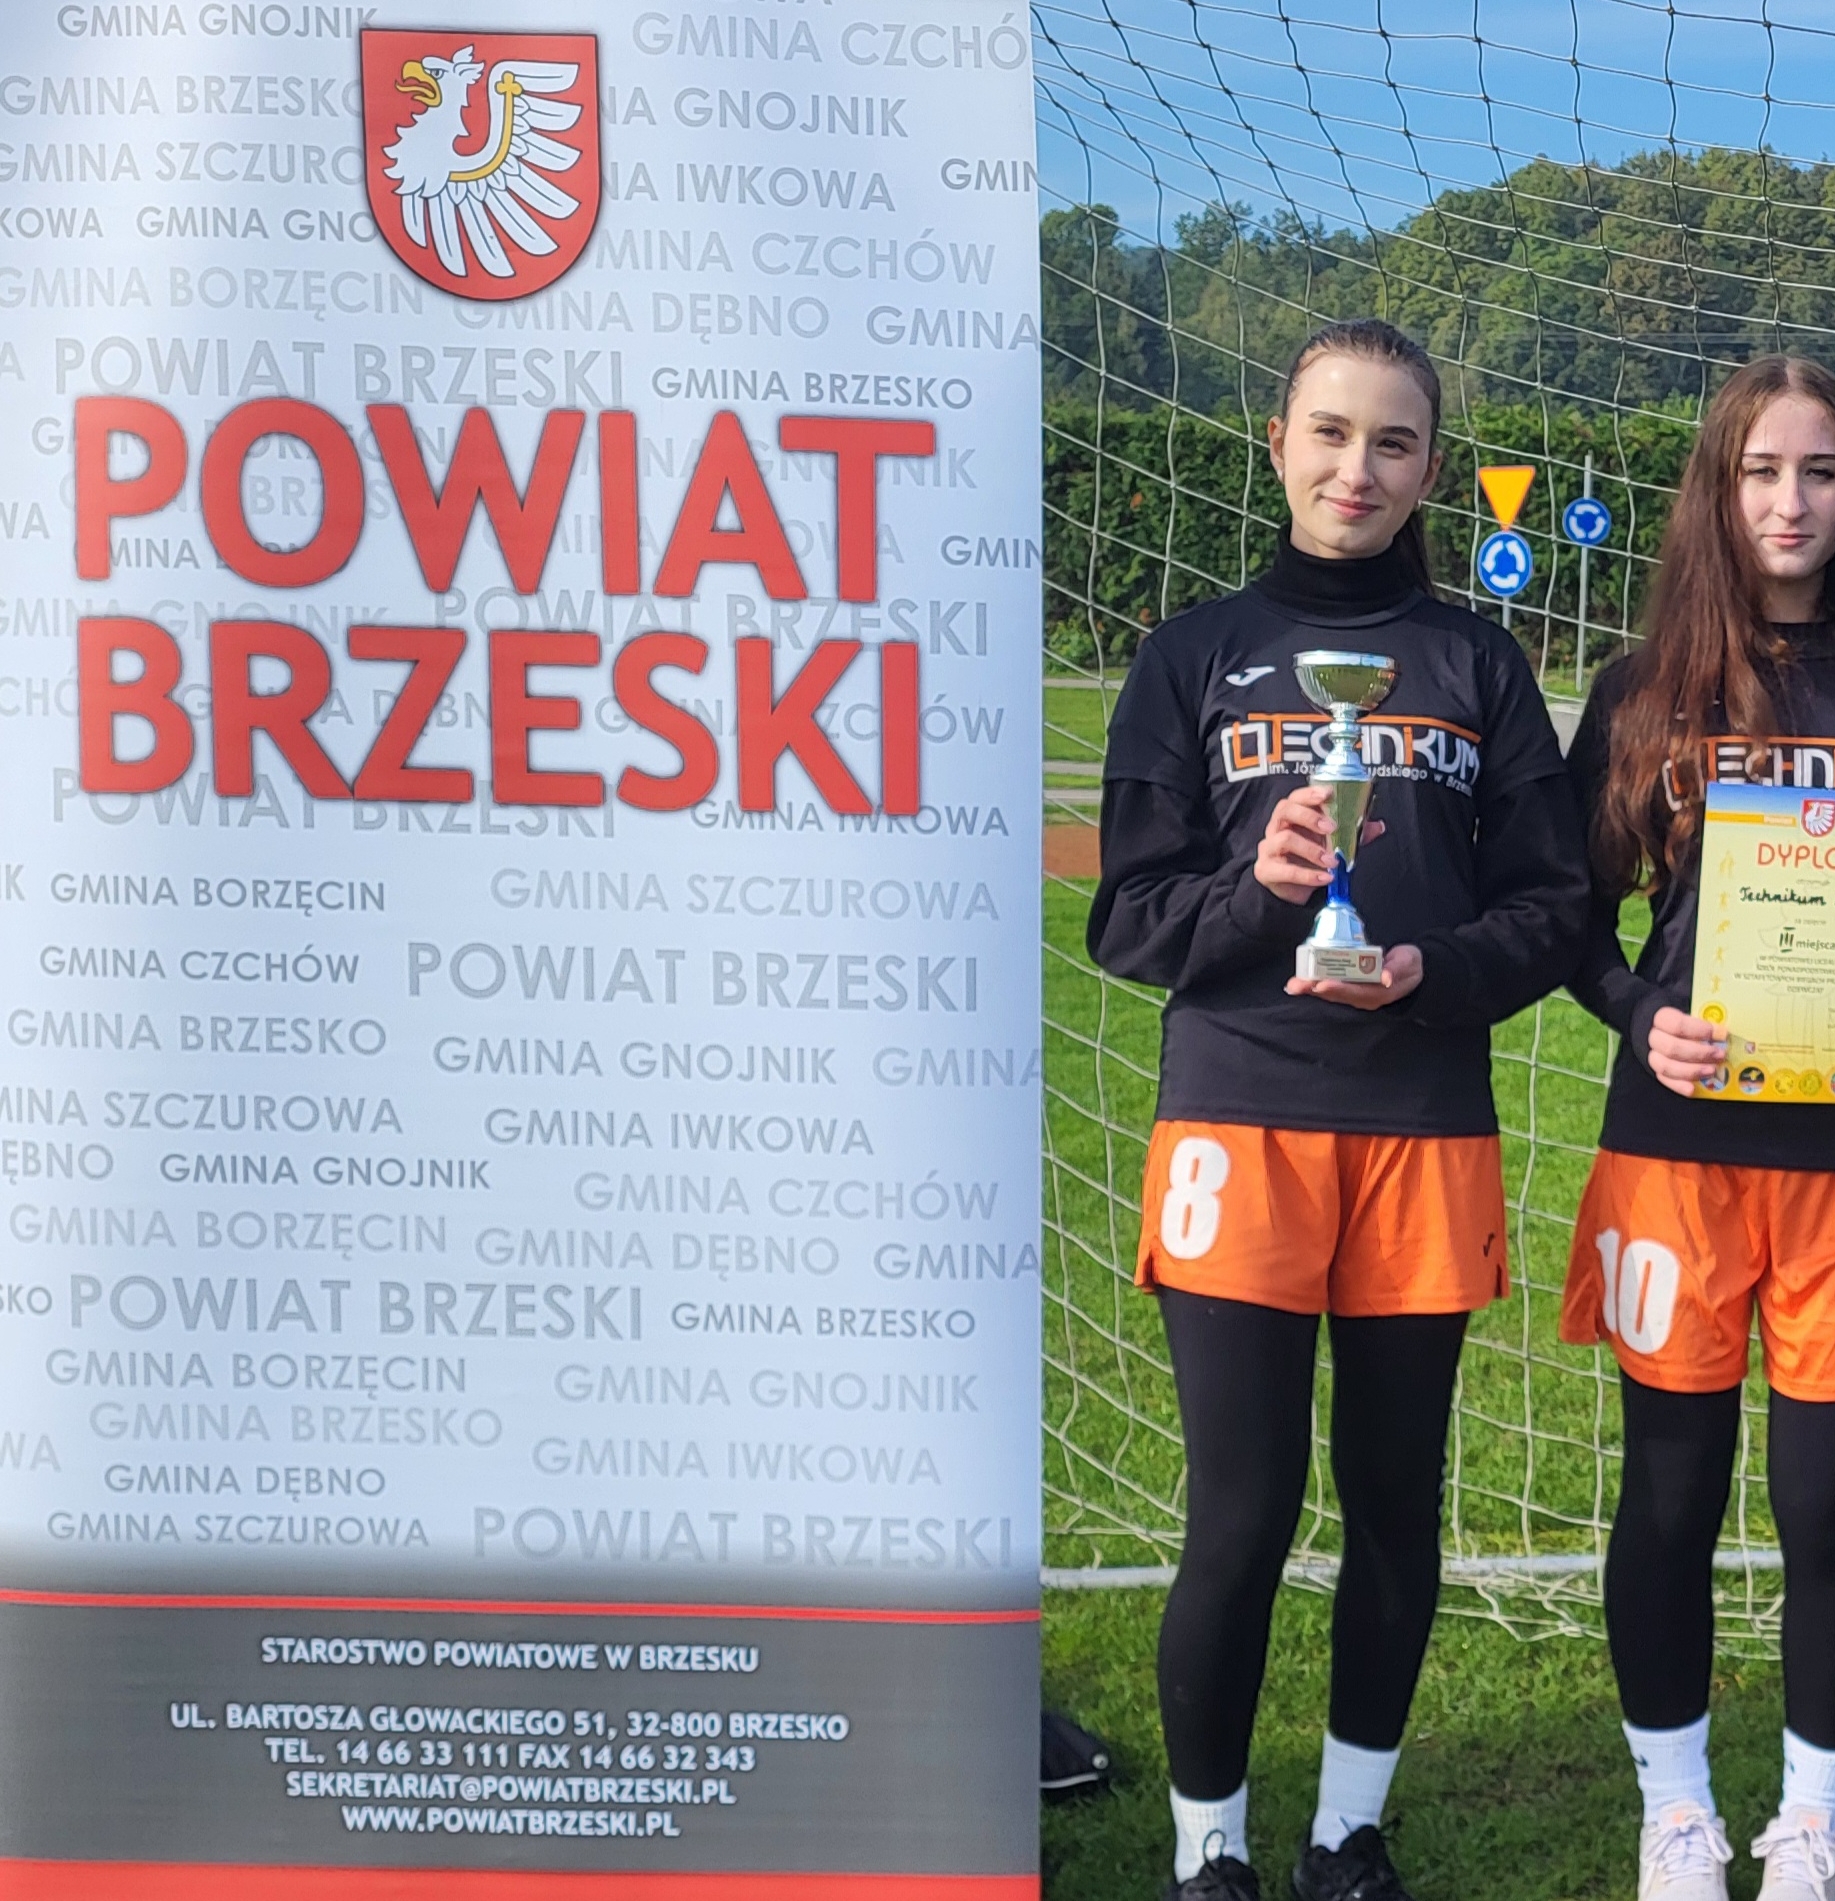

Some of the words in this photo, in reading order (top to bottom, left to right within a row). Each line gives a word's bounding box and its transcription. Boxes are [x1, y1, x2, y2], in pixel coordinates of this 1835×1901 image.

[57, 3, 187, 38] GMINA
[632, 12, 822, 63] GMINA
[0, 75, 159, 116] GMINA
[674, 86, 908, 138] GNOJNIK
[676, 162, 895, 212] IWKOWA
[136, 205, 269, 240] GMINA
[595, 229, 733, 272] MINA
[752, 228, 994, 285] CZCHÓW
[169, 266, 424, 322] BORZĘCIN
[652, 292, 829, 344] DĘBNO
[867, 306, 1040, 350] GMINA
[55, 336, 325, 397] POWIAT
[353, 343, 622, 408] BRZESKI
[652, 367, 790, 402] GMINA
[804, 371, 973, 410] BRZESKO
[74, 395, 936, 603] POWIAT
[76, 614, 920, 816] BRZESKI
[50, 873, 179, 908] GMINA
[192, 877, 386, 918] BORZĘCIN
[490, 867, 669, 913] GMINA
[687, 873, 1000, 922] SZCZUROWA
[40, 945, 167, 980] GMINA
[180, 943, 360, 984] CZCHÓW
[1796, 939, 1835, 951] miejsca
[407, 941, 685, 1005] POWIAT
[713, 950, 977, 1013] BRZESKI
[7, 1008, 162, 1051] GMINA
[180, 1015, 387, 1057] BRZESKO
[432, 1036, 603, 1078] GMINA
[619, 1041, 837, 1085] GNOJNIK
[103, 1091, 403, 1135] SZCZUROWA
[483, 1108, 652, 1149] GMINA
[671, 1112, 874, 1155] IWKOWA
[160, 1152, 299, 1186] GMINA
[312, 1156, 491, 1190] GNOJNIK
[573, 1171, 750, 1216] GMINA
[768, 1170, 999, 1222] CZCHÓW
[1159, 1135, 1231, 1260] 8
[9, 1203, 177, 1248] GMINA
[197, 1210, 447, 1260] BORZĘCIN
[475, 1227, 652, 1270] GMINA
[672, 1233, 839, 1281] DĘBNO
[874, 1243, 1039, 1281] GMINA
[71, 1273, 351, 1332] POWIAT
[379, 1281, 642, 1342] BRZESKI
[1596, 1227, 1681, 1355] 10
[671, 1302, 802, 1336] GMINA
[816, 1307, 976, 1340] BRZESKO
[45, 1349, 213, 1389] GMINA
[232, 1352, 466, 1400] BORZĘCIN
[554, 1364, 731, 1406] GMINA
[749, 1368, 979, 1412] GNOJNIK
[89, 1402, 270, 1442] GMINA
[292, 1406, 502, 1448] BRZESKO
[104, 1462, 241, 1495] GMINA
[256, 1465, 386, 1503] DĘBNO
[532, 1436, 708, 1478] GMINA
[728, 1442, 941, 1486] IWKOWA
[47, 1510, 181, 1543] GMINA
[195, 1513, 429, 1548] SZCZUROWA
[473, 1506, 738, 1563] POWIAT
[762, 1512, 1012, 1571] BRZESKI
[261, 1637, 428, 1667] STAROSTWO
[434, 1640, 598, 1670] POWIATOWE
[605, 1643, 636, 1671] W
[639, 1644, 760, 1672] BRZESKU
[170, 1703, 216, 1729] UL.
[226, 1704, 364, 1732] BARTOSZA
[369, 1707, 566, 1737] GŁOWACKIEGO
[573, 1711, 618, 1741] 51,
[626, 1712, 721, 1739] 32-800
[729, 1713, 849, 1741] BRZESKO
[265, 1738, 325, 1764] TEL.
[337, 1740, 370, 1765] 14
[376, 1740, 412, 1766] 66
[419, 1741, 454, 1767] 33
[461, 1743, 509, 1768] 111
[518, 1744, 572, 1769] FAX
[579, 1744, 612, 1769] 14
[617, 1745, 656, 1771] 66
[662, 1745, 698, 1771] 32
[704, 1746, 756, 1772] 343
[285, 1772, 737, 1804] SEKRETARIAT@POWIATBRZESKI.PL
[342, 1806, 681, 1837] WWW.POWIATBRZESKI.PL
